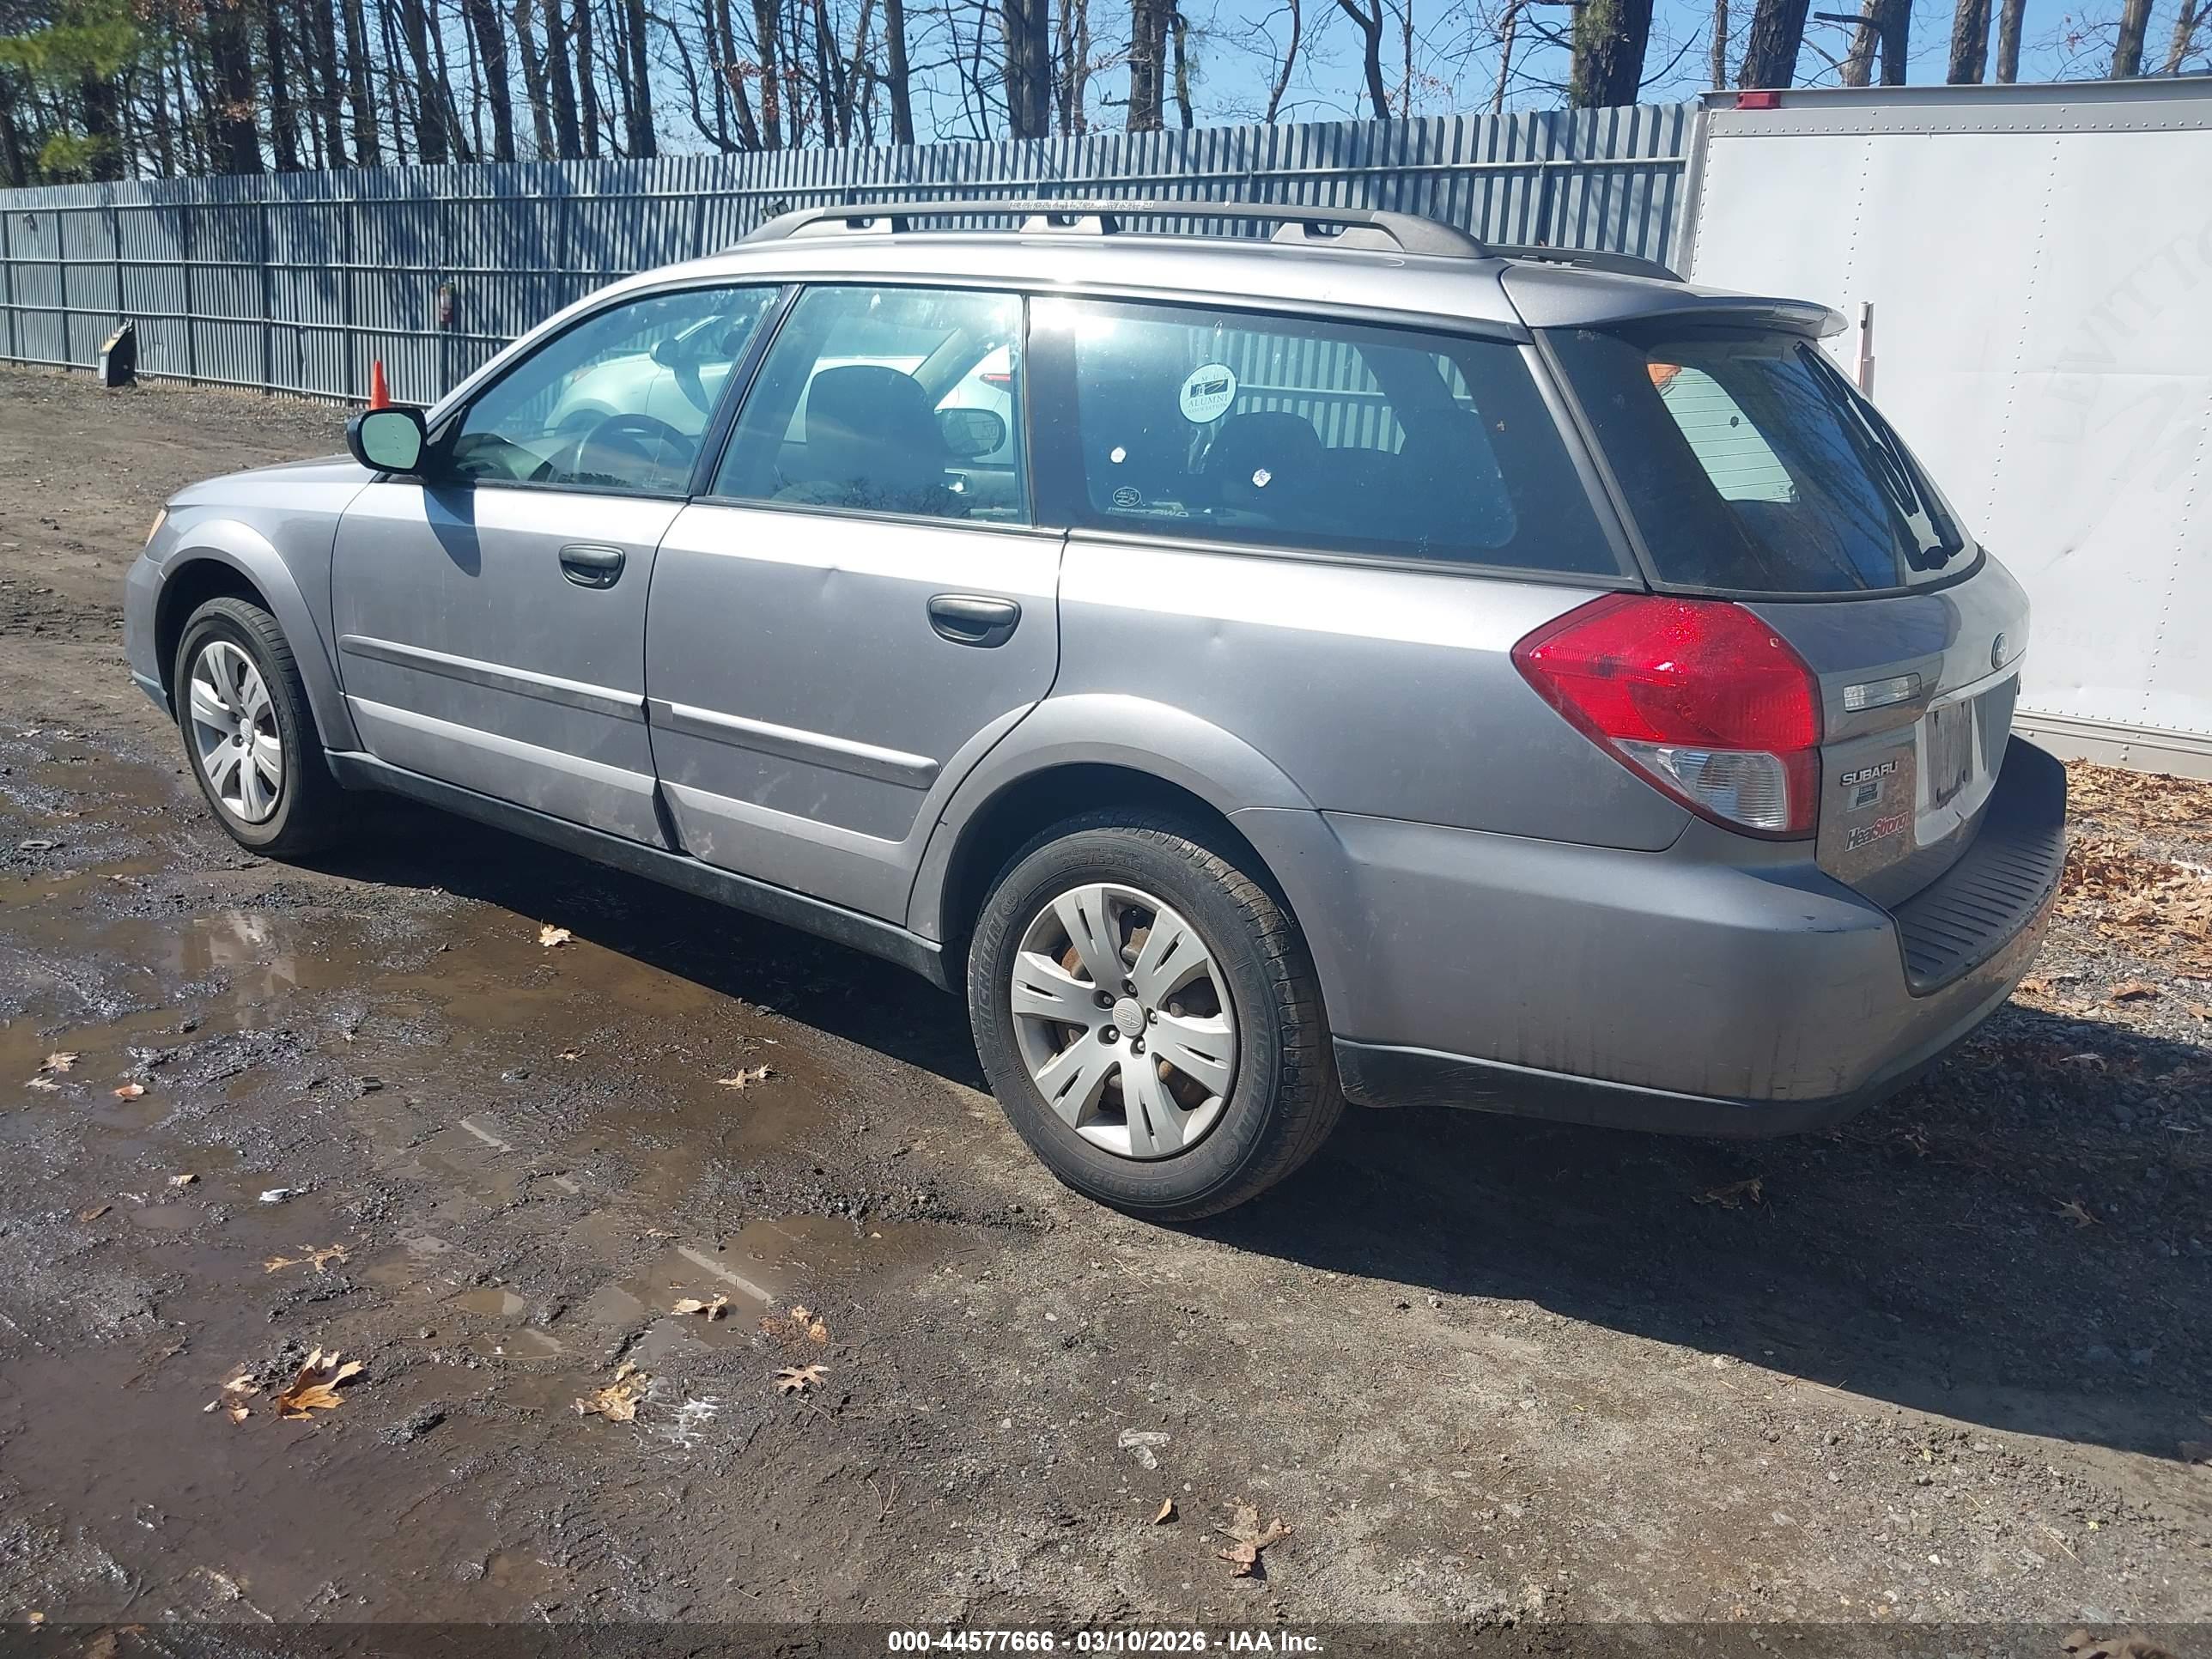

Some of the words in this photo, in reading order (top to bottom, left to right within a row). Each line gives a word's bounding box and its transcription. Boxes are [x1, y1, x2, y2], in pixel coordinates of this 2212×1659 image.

[1188, 394, 1228, 407] ALUMNI
[1840, 760, 1899, 787] SUBARU
[977, 914, 1005, 1038] MICHELIN
